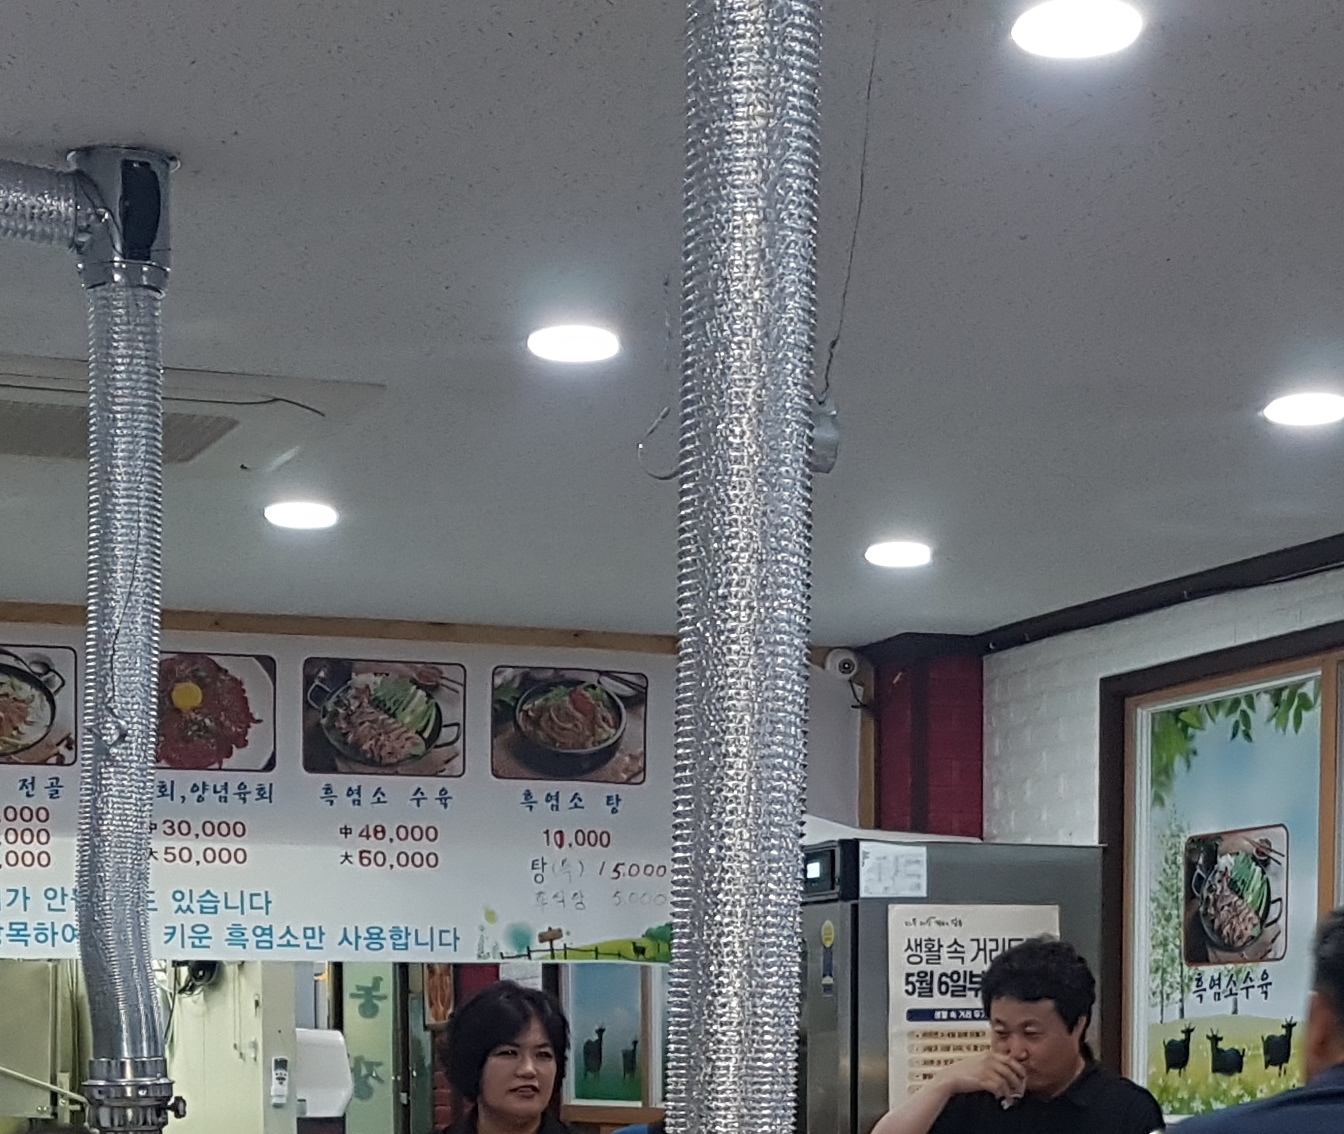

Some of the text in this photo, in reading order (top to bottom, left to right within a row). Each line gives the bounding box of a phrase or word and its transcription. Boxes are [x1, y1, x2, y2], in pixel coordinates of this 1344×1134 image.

[18, 776, 64, 799] 전골
[319, 783, 453, 810] 흑염소 수육
[520, 789, 622, 814] 흑염소 탕
[162, 820, 246, 839] 30,000
[339, 824, 353, 839] 中
[163, 846, 247, 866] 50,000
[340, 851, 353, 865] 大
[44, 886, 79, 912] 안
[172, 889, 272, 915] 있습니다
[164, 923, 213, 949] 키운
[224, 923, 326, 950] 흑염소만
[338, 925, 460, 952] 사용합니다
[904, 937, 943, 965] 생활
[946, 938, 965, 965] 속
[904, 970, 934, 998] 5월
[1192, 969, 1272, 1004] 흑염소수육
